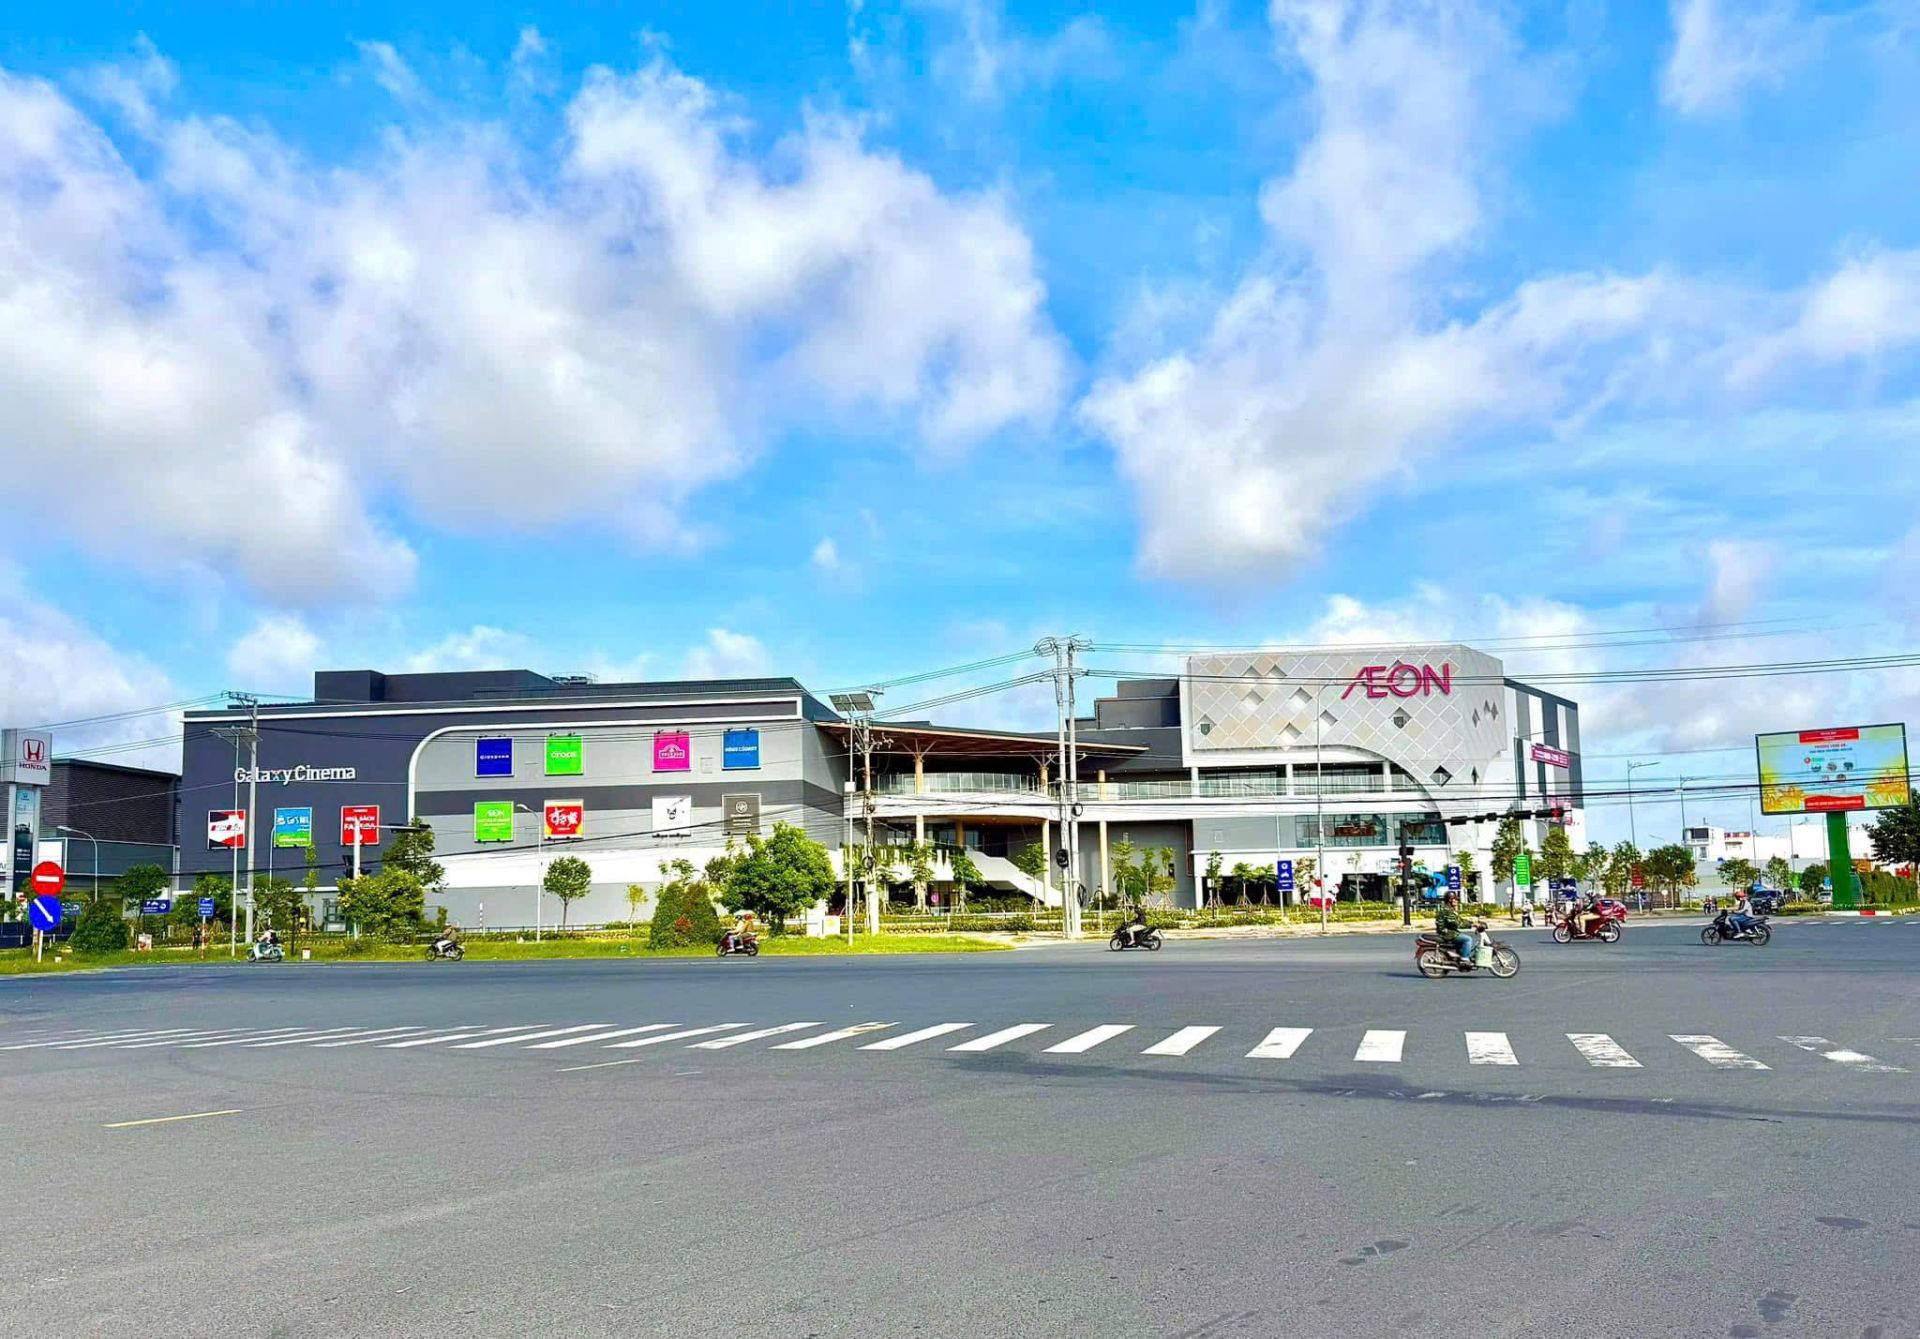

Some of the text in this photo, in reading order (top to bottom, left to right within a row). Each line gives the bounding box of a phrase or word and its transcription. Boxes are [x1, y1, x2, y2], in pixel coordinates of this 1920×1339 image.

[19, 762, 47, 771] HONDA
[234, 765, 356, 785] Galaxy Cinema
